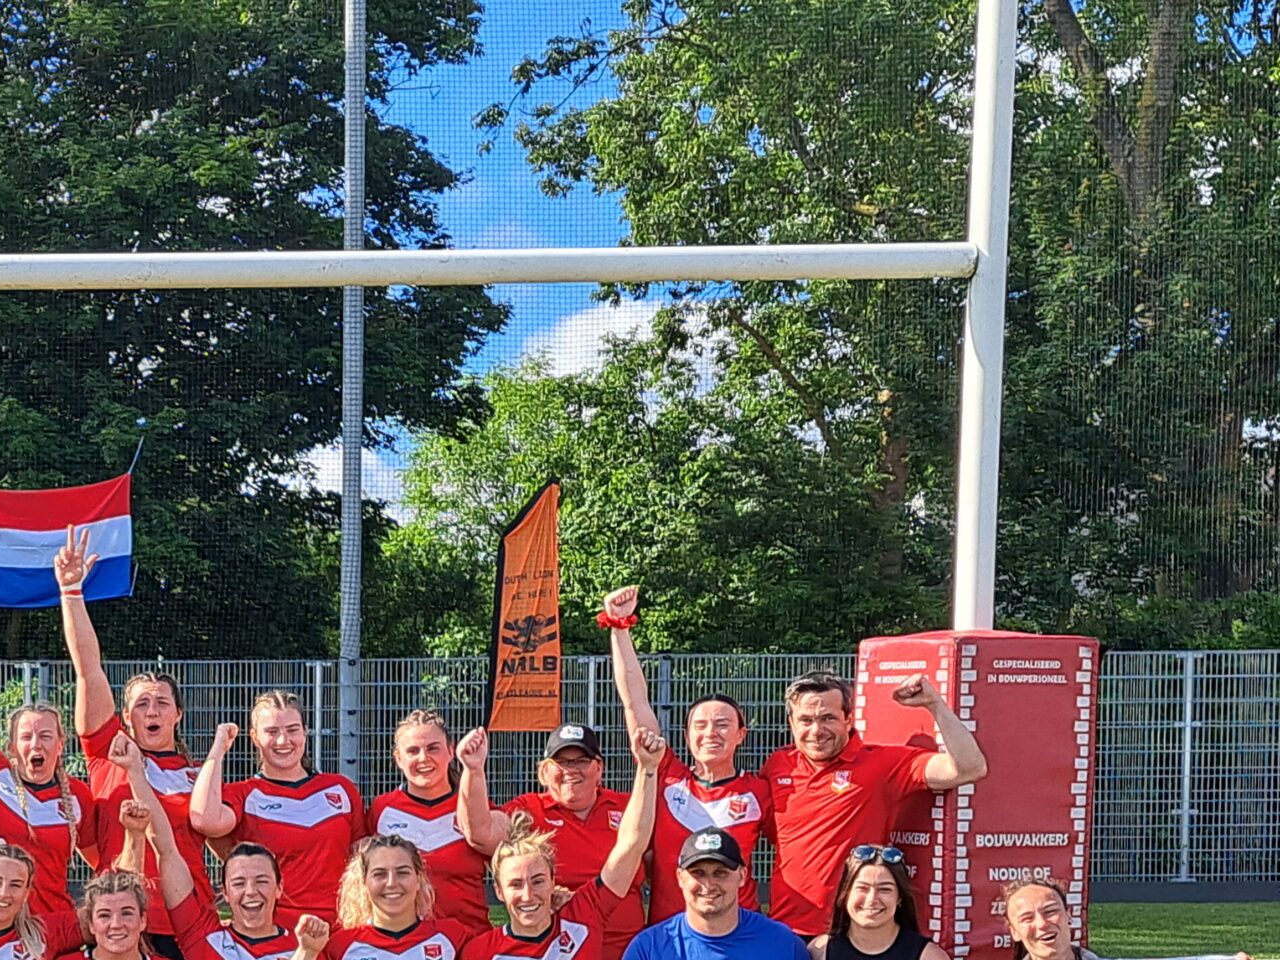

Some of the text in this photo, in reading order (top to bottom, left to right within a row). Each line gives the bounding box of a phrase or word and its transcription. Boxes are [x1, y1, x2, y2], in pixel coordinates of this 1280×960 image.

[993, 660, 1061, 669] GESPECIALISEERD
[987, 674, 1068, 684] IN BOUWPERSONEEL
[889, 832, 930, 846] VAKKERS
[975, 833, 1069, 848] BOUWVAKKERS
[989, 867, 1051, 881] NODIG OF
